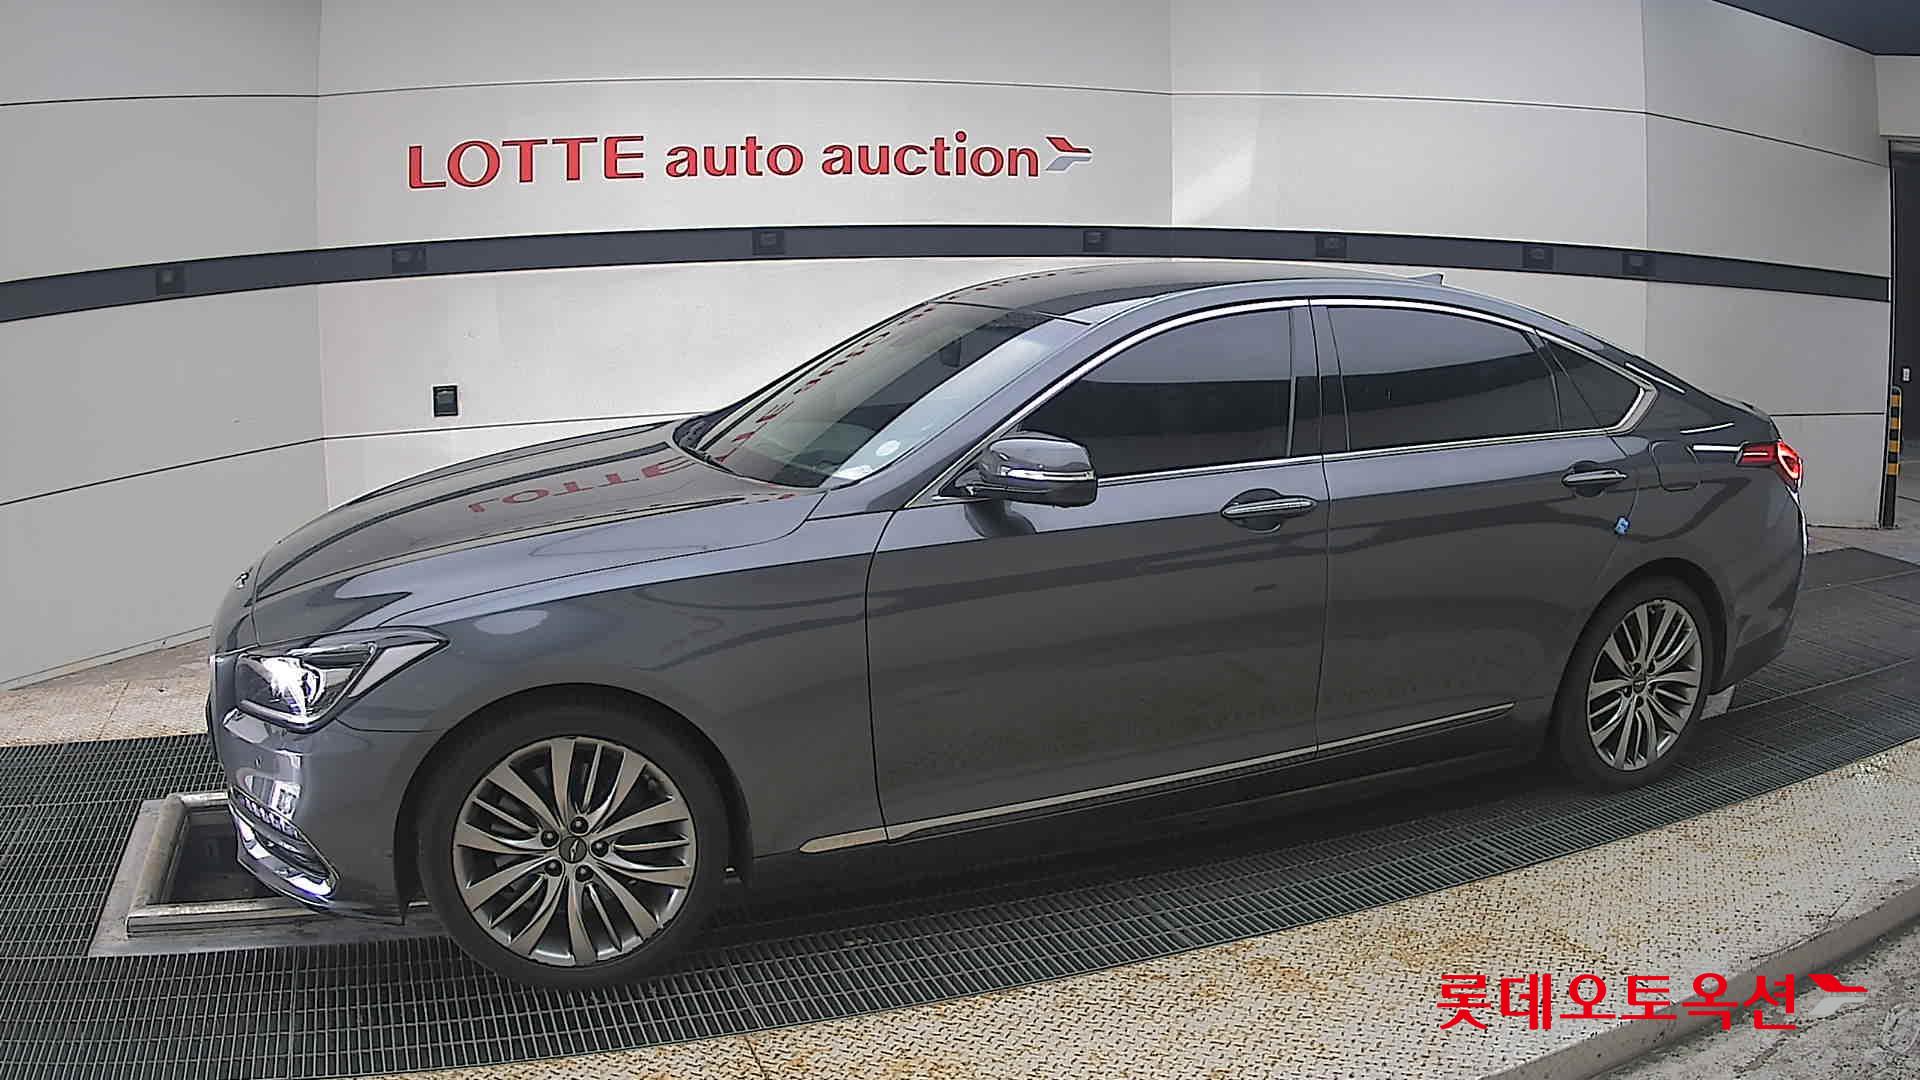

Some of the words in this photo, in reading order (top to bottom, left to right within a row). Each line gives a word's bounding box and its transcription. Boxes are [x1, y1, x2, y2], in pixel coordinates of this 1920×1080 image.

[408, 135, 644, 189] LOTTE
[665, 136, 805, 177] auto
[821, 131, 1039, 177] auction
